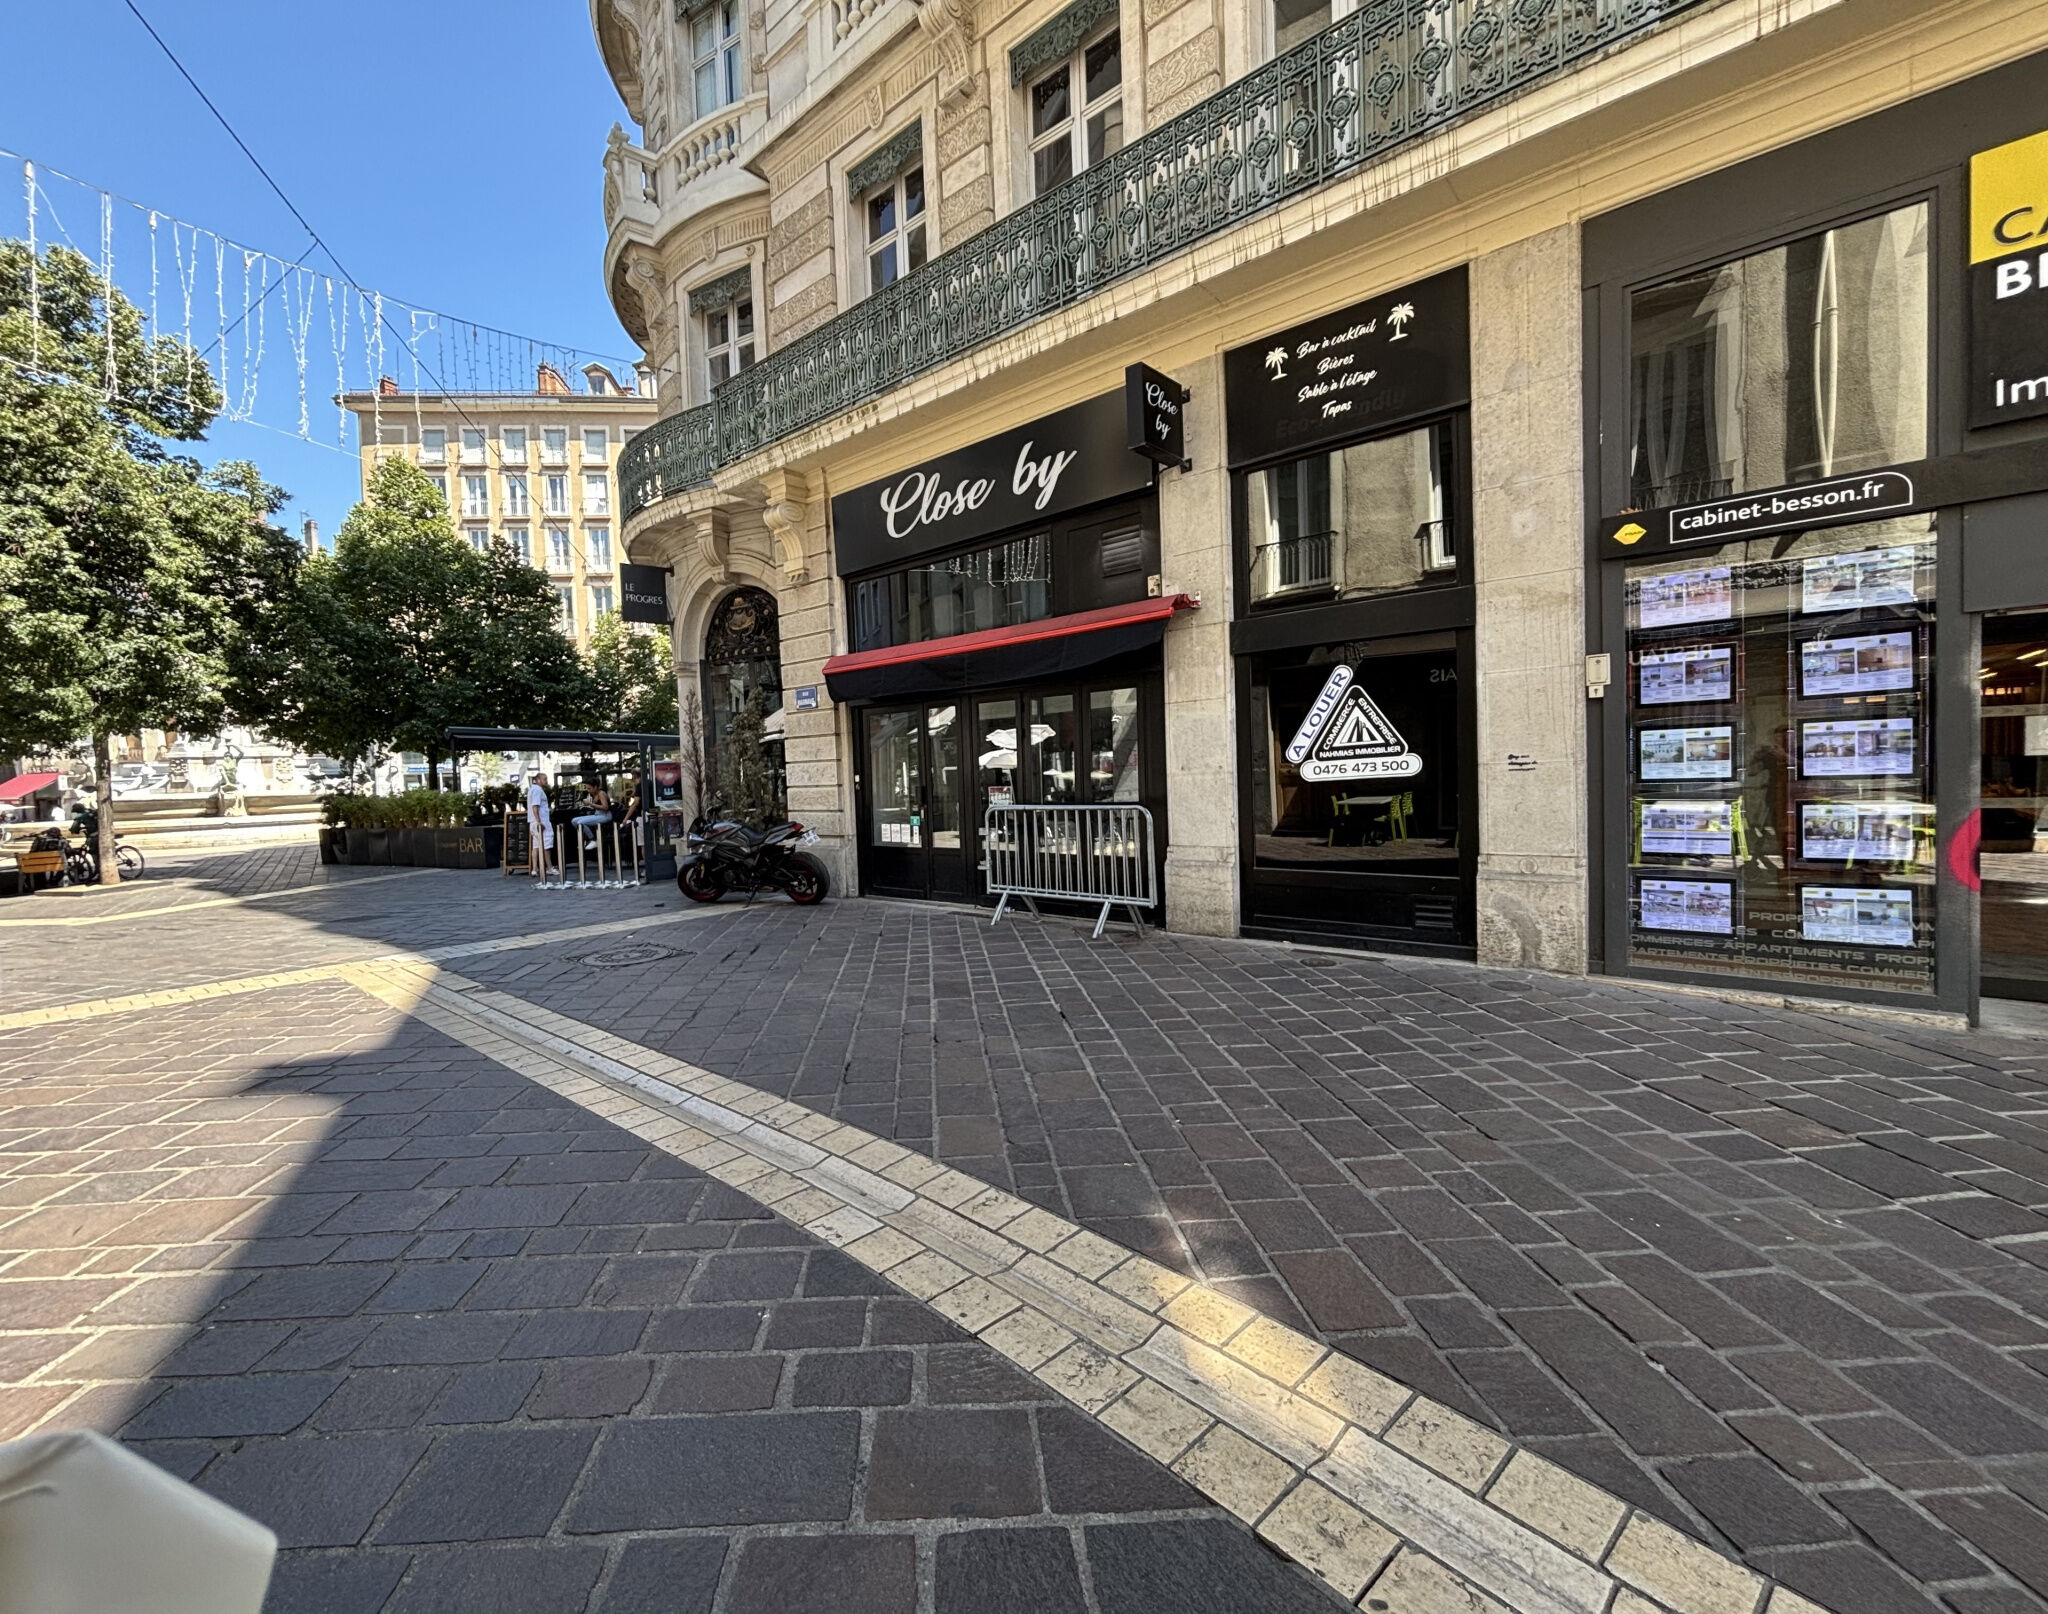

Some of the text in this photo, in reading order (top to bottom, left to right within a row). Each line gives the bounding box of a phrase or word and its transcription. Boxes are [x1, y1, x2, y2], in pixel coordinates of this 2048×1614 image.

[1296, 318, 1377, 359] Bar à cocktail
[1316, 354, 1355, 375] Bières
[1145, 381, 1178, 415] Close
[1297, 382, 1329, 403] Sable
[1330, 379, 1338, 391] à
[1321, 400, 1352, 419] Tapas
[1155, 414, 1171, 440] by
[880, 441, 1077, 538] Close by
[1679, 480, 1885, 530] cabinet-besson.fr
[625, 582, 635, 592] LE
[1292, 672, 1348, 758] A LOUER
[1323, 697, 1356, 750] COMMERCE
[1358, 697, 1398, 746] ENTREPRISE
[1319, 745, 1401, 758] NAHMIAS IMMOBILIER
[1313, 760, 1410, 776] 0476 473 500
[459, 837, 484, 853] BAR
